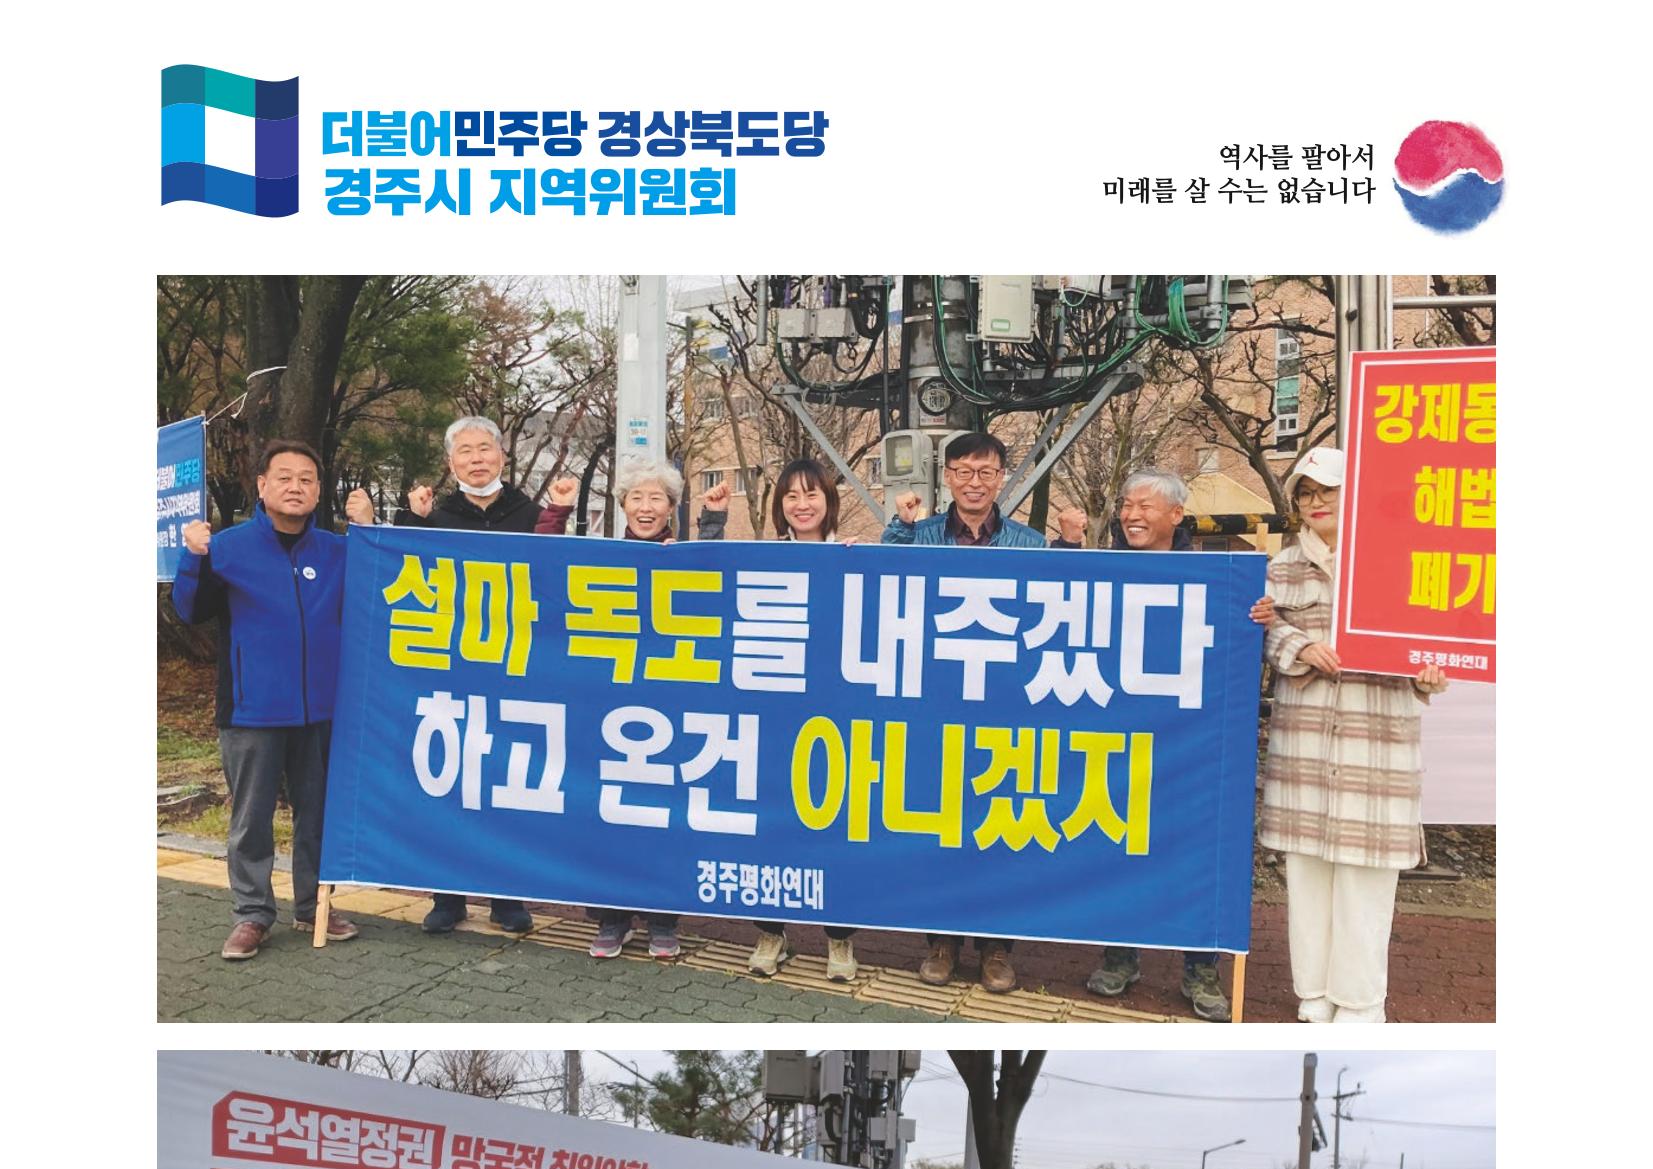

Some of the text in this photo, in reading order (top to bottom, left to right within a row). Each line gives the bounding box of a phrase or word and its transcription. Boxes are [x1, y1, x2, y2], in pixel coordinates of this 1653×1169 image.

[1414, 466, 1496, 529] 해법
[1408, 551, 1496, 614] 폐기
[382, 555, 1215, 709] 설마 독도를 내주겠다
[1409, 649, 1488, 670] 경주평화연대
[412, 690, 1154, 855] 하고 온건 아니겠지
[697, 860, 824, 911] 경주평화연대
